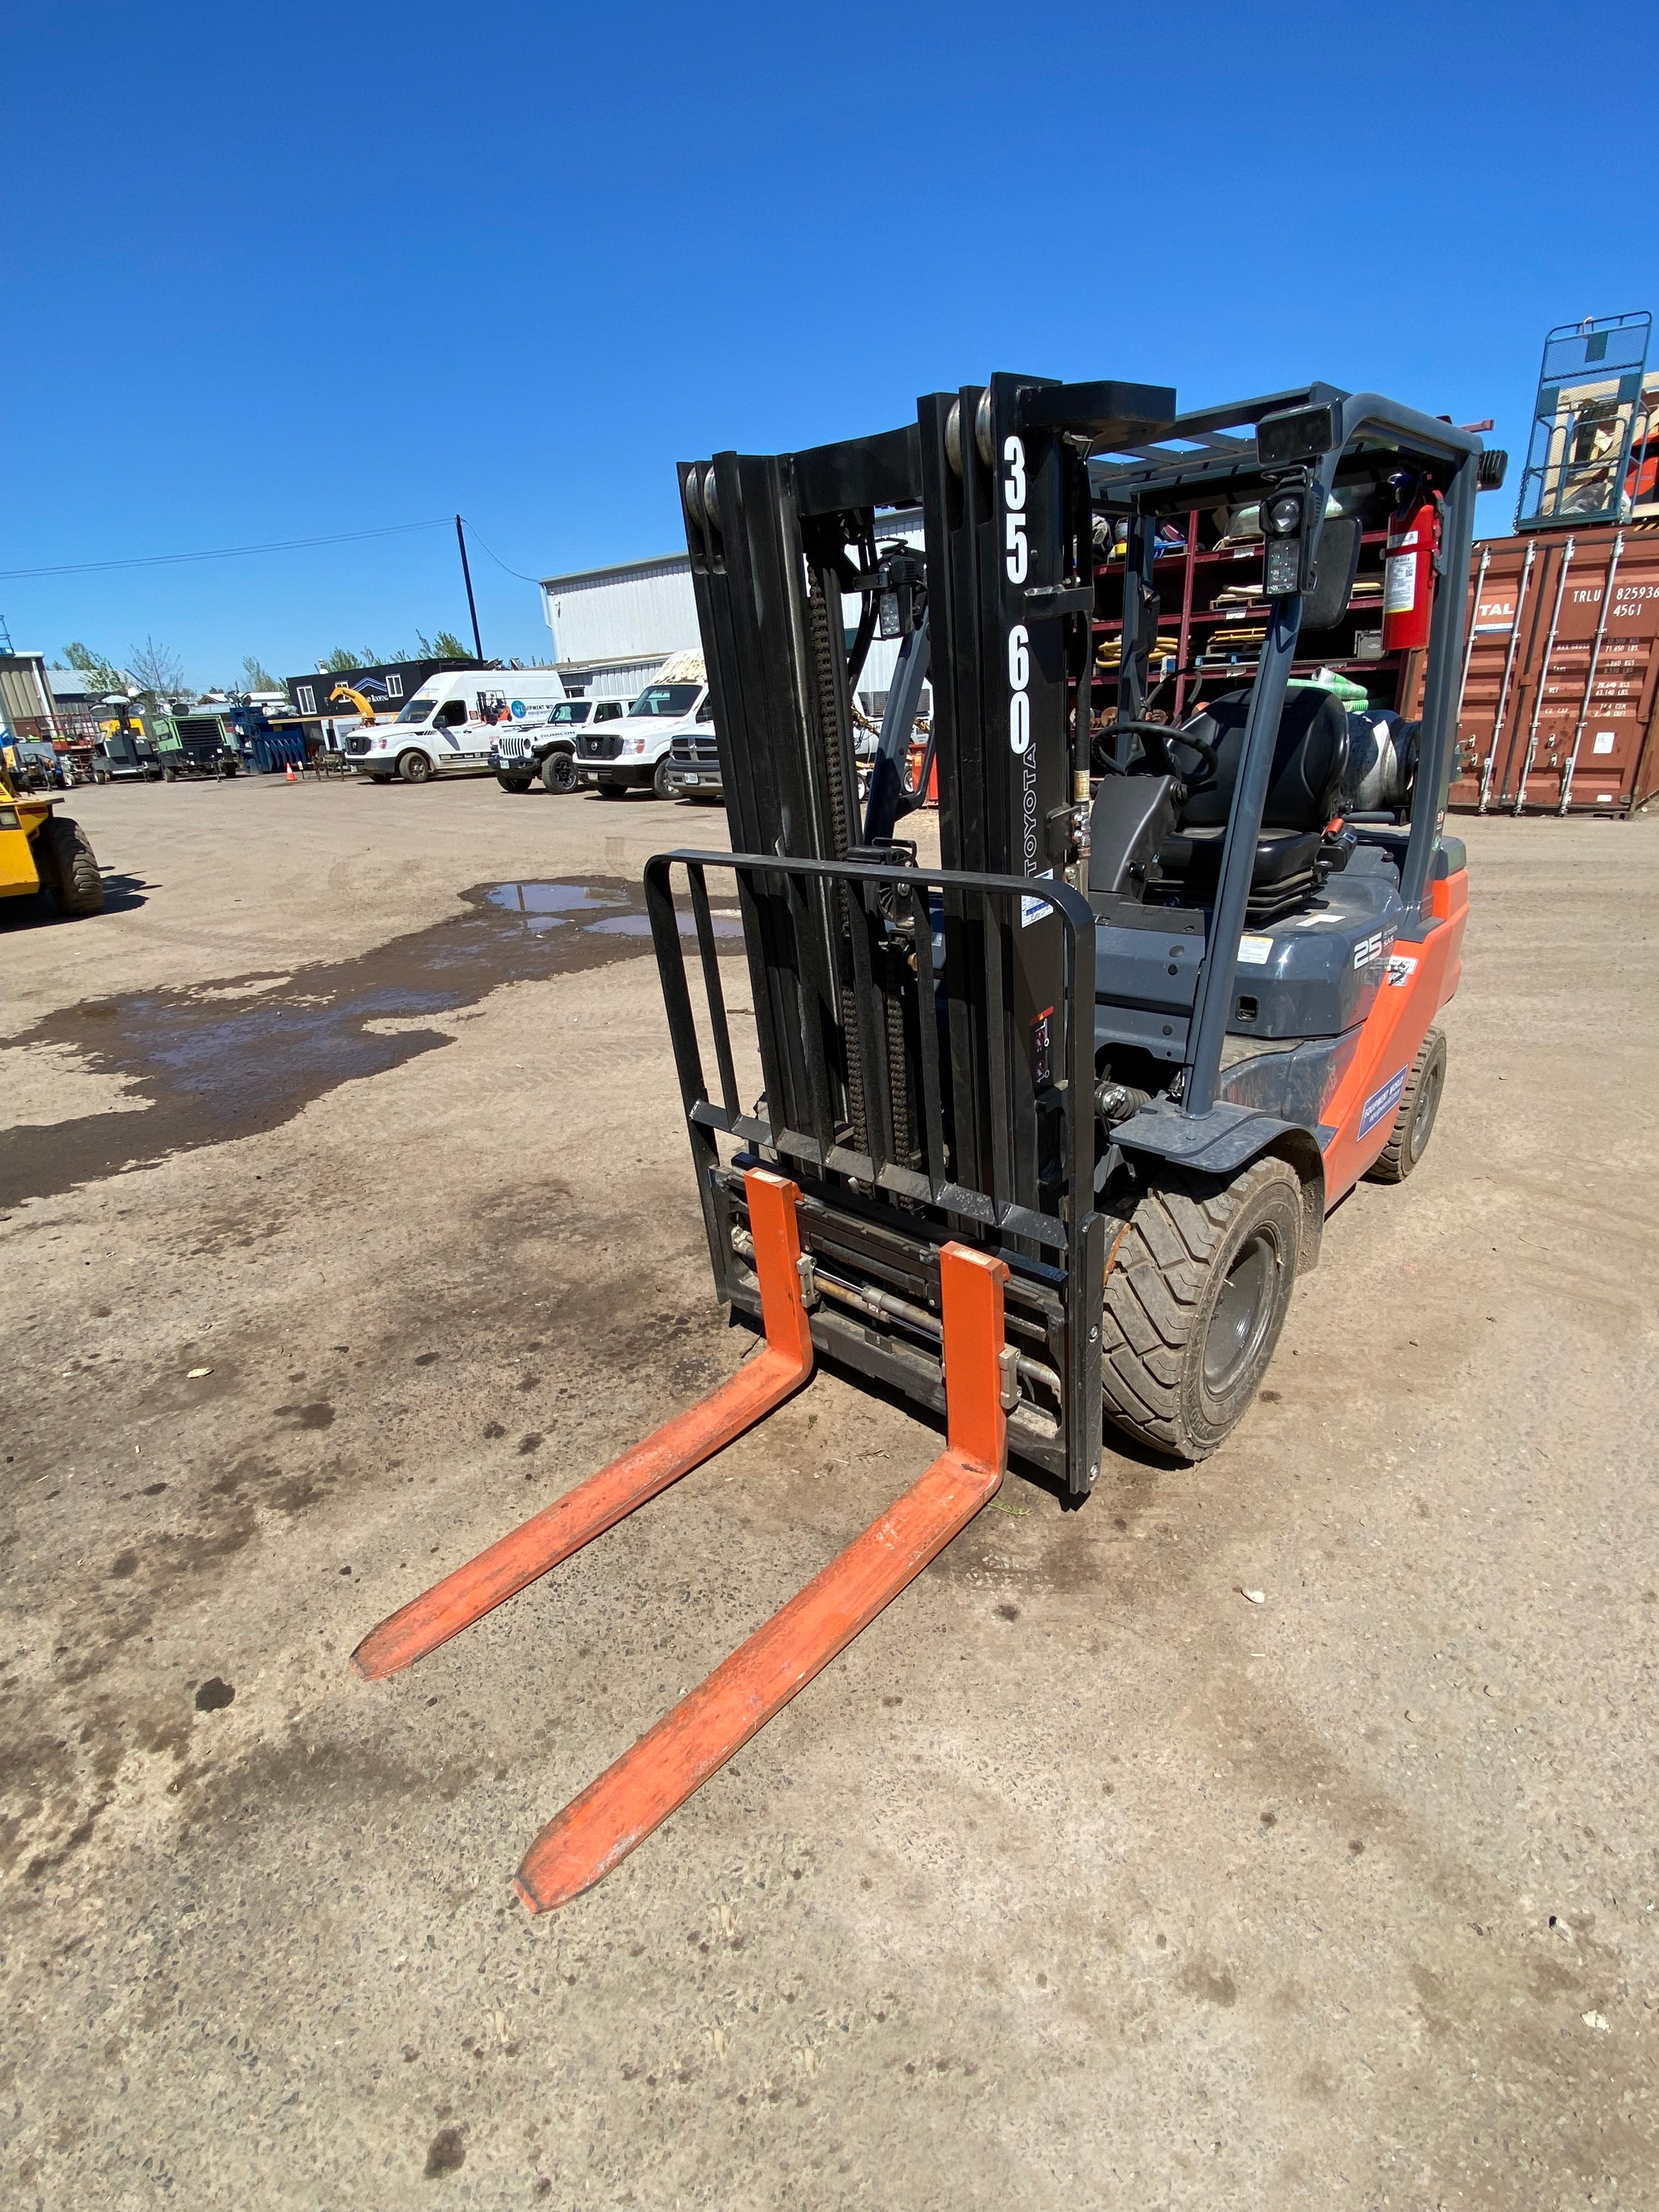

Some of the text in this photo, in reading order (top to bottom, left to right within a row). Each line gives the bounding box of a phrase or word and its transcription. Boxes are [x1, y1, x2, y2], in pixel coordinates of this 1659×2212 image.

[1573, 586, 1659, 603] TRLU 825936
[1479, 603, 1514, 617] TAL
[1023, 742, 1037, 878] TOYOTA
[1354, 932, 1383, 970] 25
